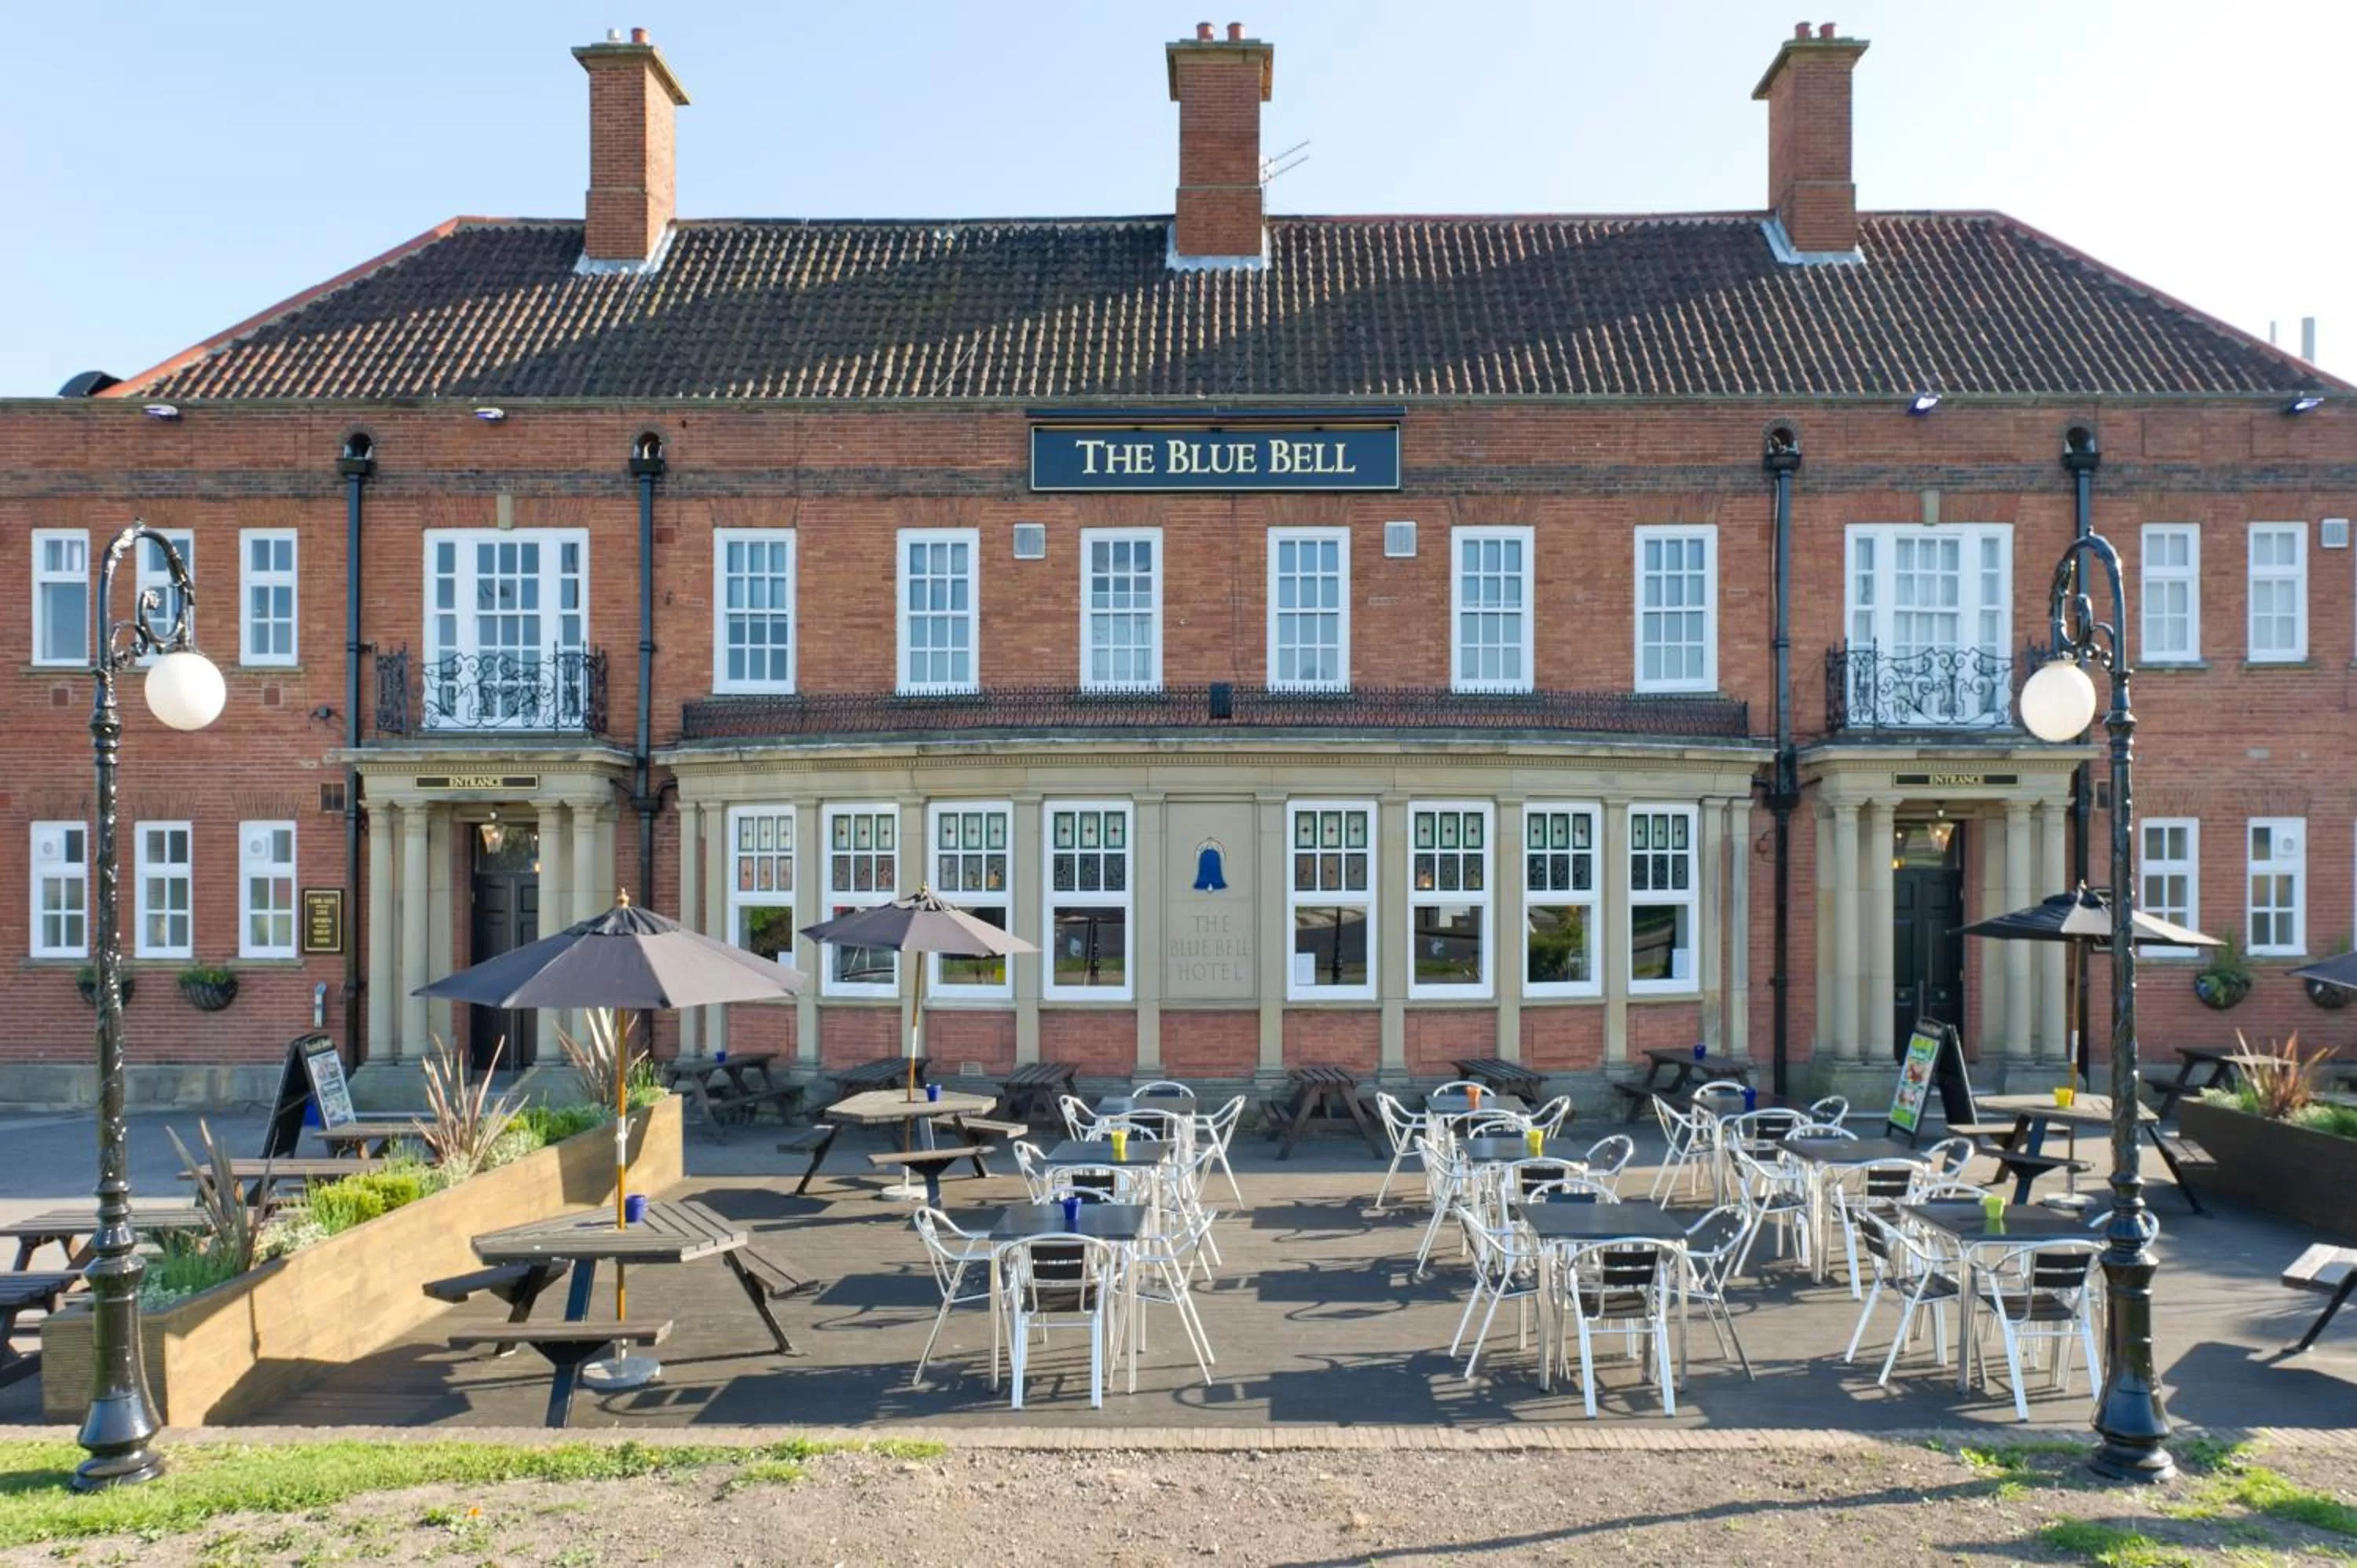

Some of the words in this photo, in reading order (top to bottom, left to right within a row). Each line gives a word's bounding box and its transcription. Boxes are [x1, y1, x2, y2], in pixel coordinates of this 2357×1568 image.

[1075, 439, 1156, 474] THE
[1166, 439, 1257, 474] BLUE
[1268, 439, 1356, 474] BELL
[450, 776, 502, 788] ENTRANCE
[1189, 914, 1230, 933] THE
[1177, 961, 1244, 981] HOTEL
